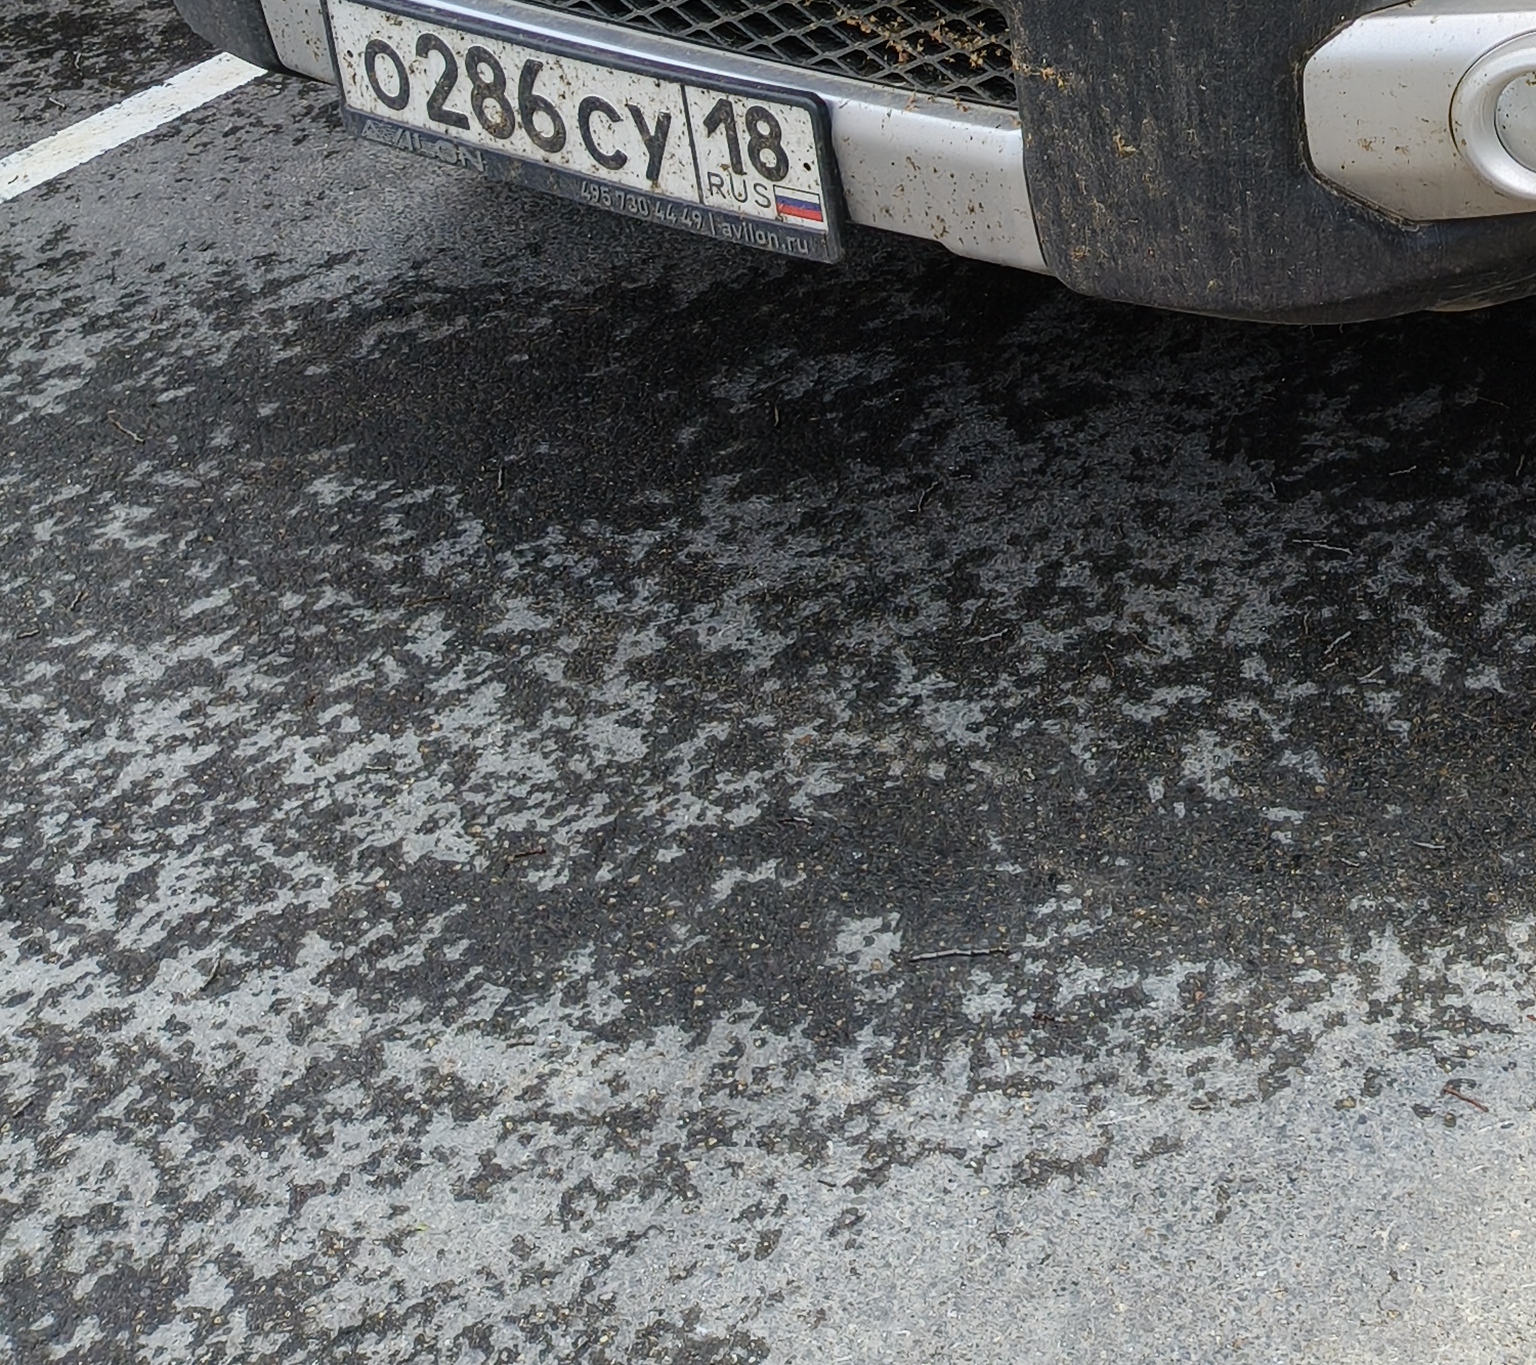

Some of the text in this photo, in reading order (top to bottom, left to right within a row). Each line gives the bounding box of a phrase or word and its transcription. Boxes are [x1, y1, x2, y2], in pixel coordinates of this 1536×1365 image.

[702, 97, 791, 183] 18
[580, 180, 809, 255] 495 730 44 49 avilon.ru
[707, 171, 773, 210] RUS
